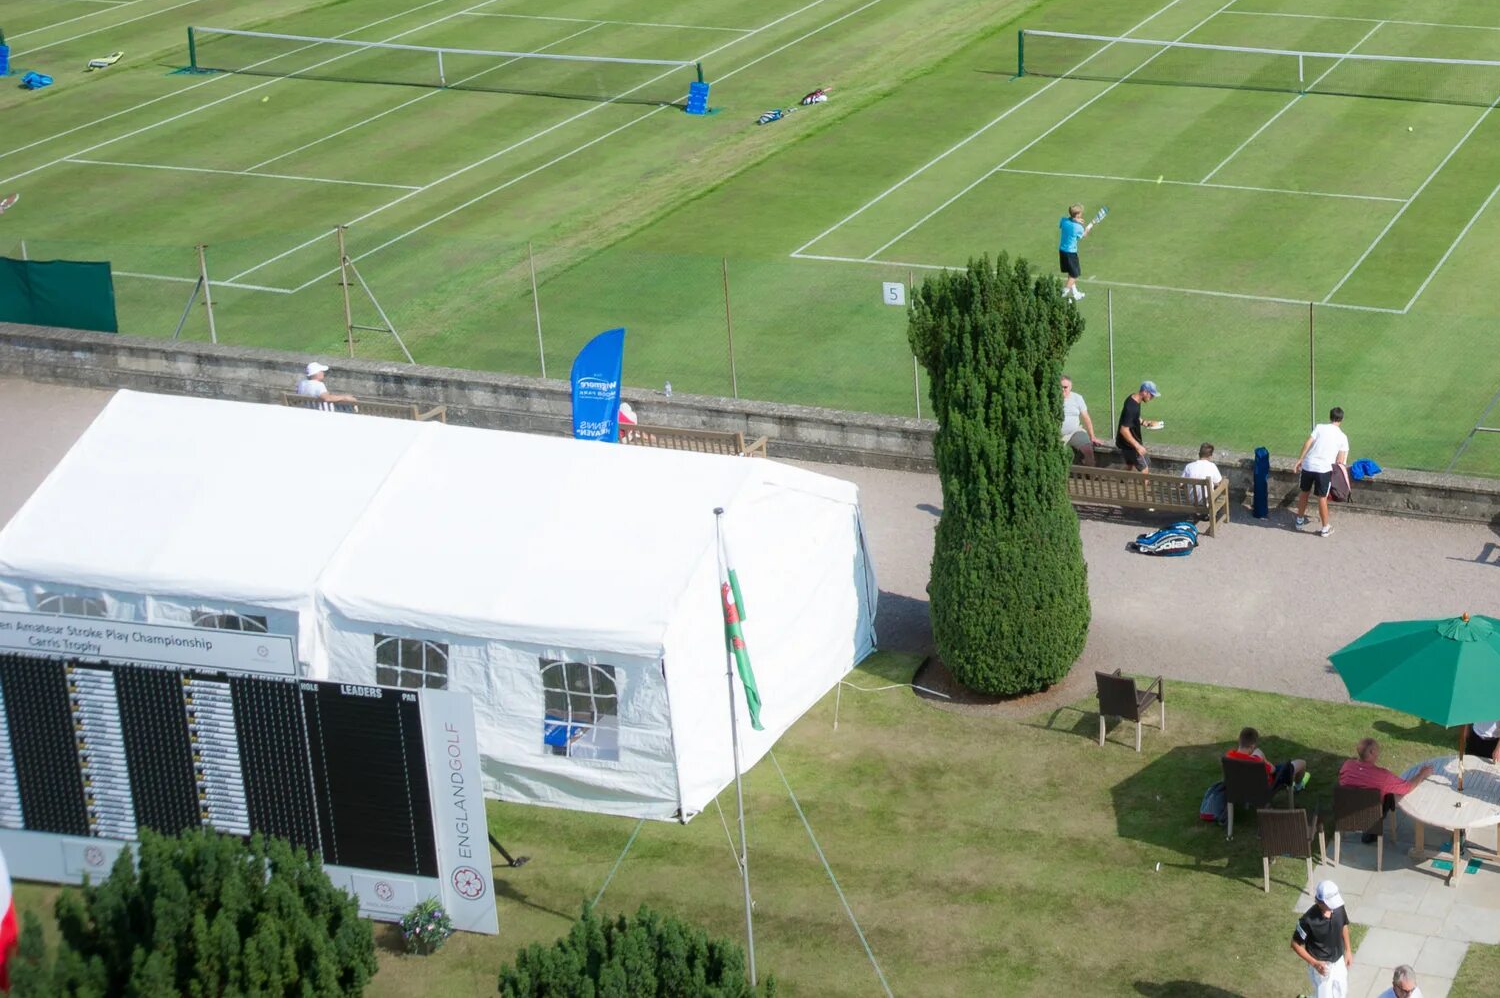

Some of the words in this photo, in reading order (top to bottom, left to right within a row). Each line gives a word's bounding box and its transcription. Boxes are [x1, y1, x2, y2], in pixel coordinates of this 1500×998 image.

[890, 287, 898, 301] 5
[16, 621, 63, 635] Amateur
[67, 625, 103, 639] Stroke
[106, 629, 129, 643] Play
[132, 631, 213, 651] Championship
[28, 635, 60, 649] Carris
[63, 639, 101, 653] Trophy
[340, 684, 383, 699] LEADERS
